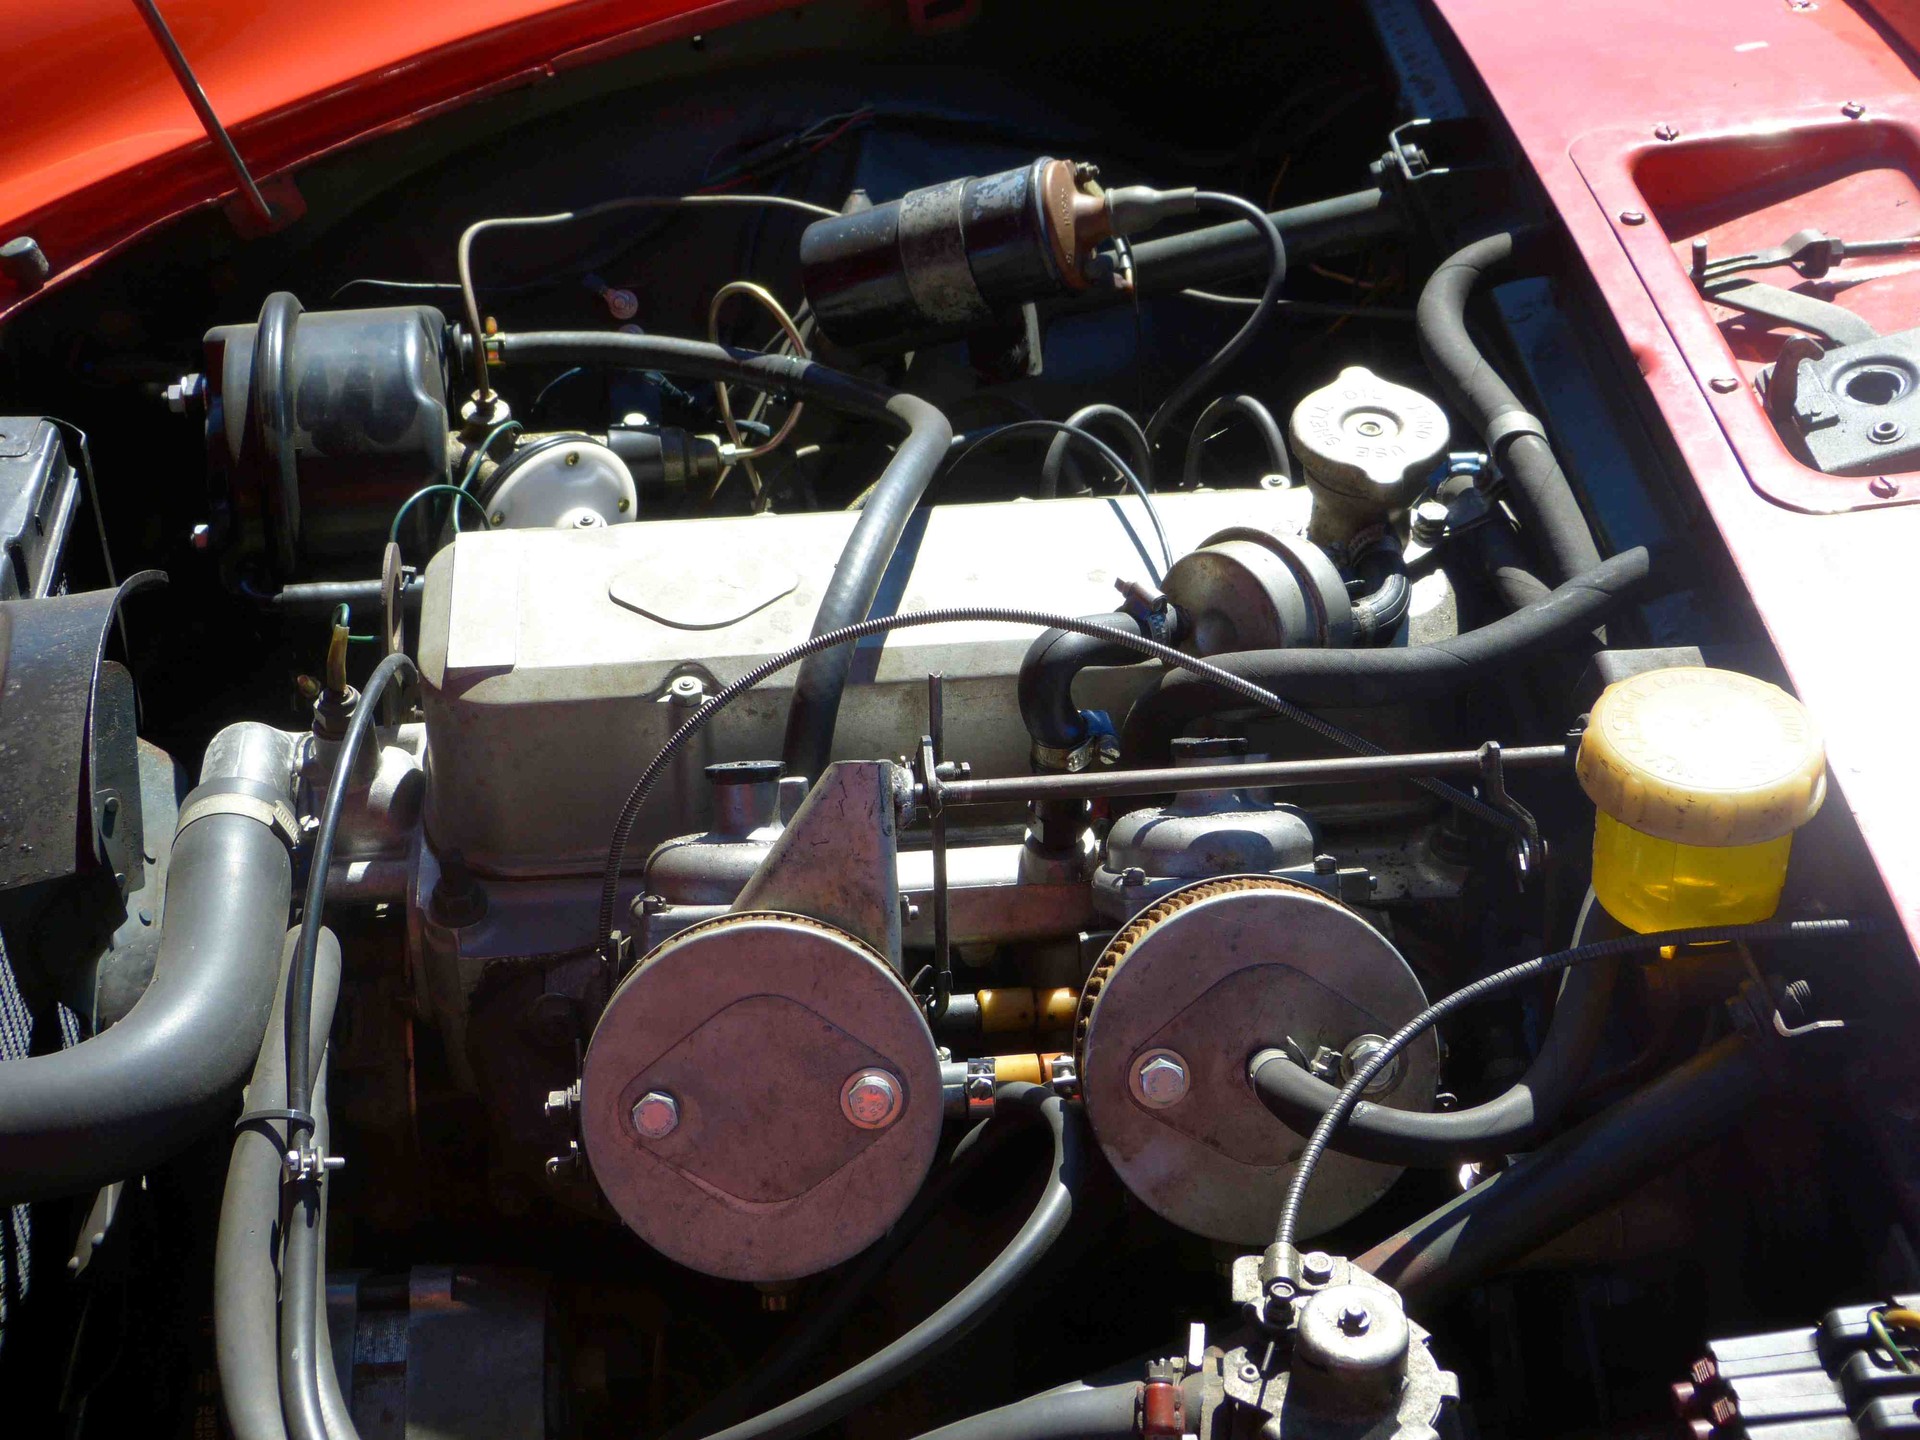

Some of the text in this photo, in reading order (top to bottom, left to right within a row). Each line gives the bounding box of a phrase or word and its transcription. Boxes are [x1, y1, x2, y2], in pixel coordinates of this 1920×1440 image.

[1309, 387, 1433, 458] USE SHELL OIL ONLY
